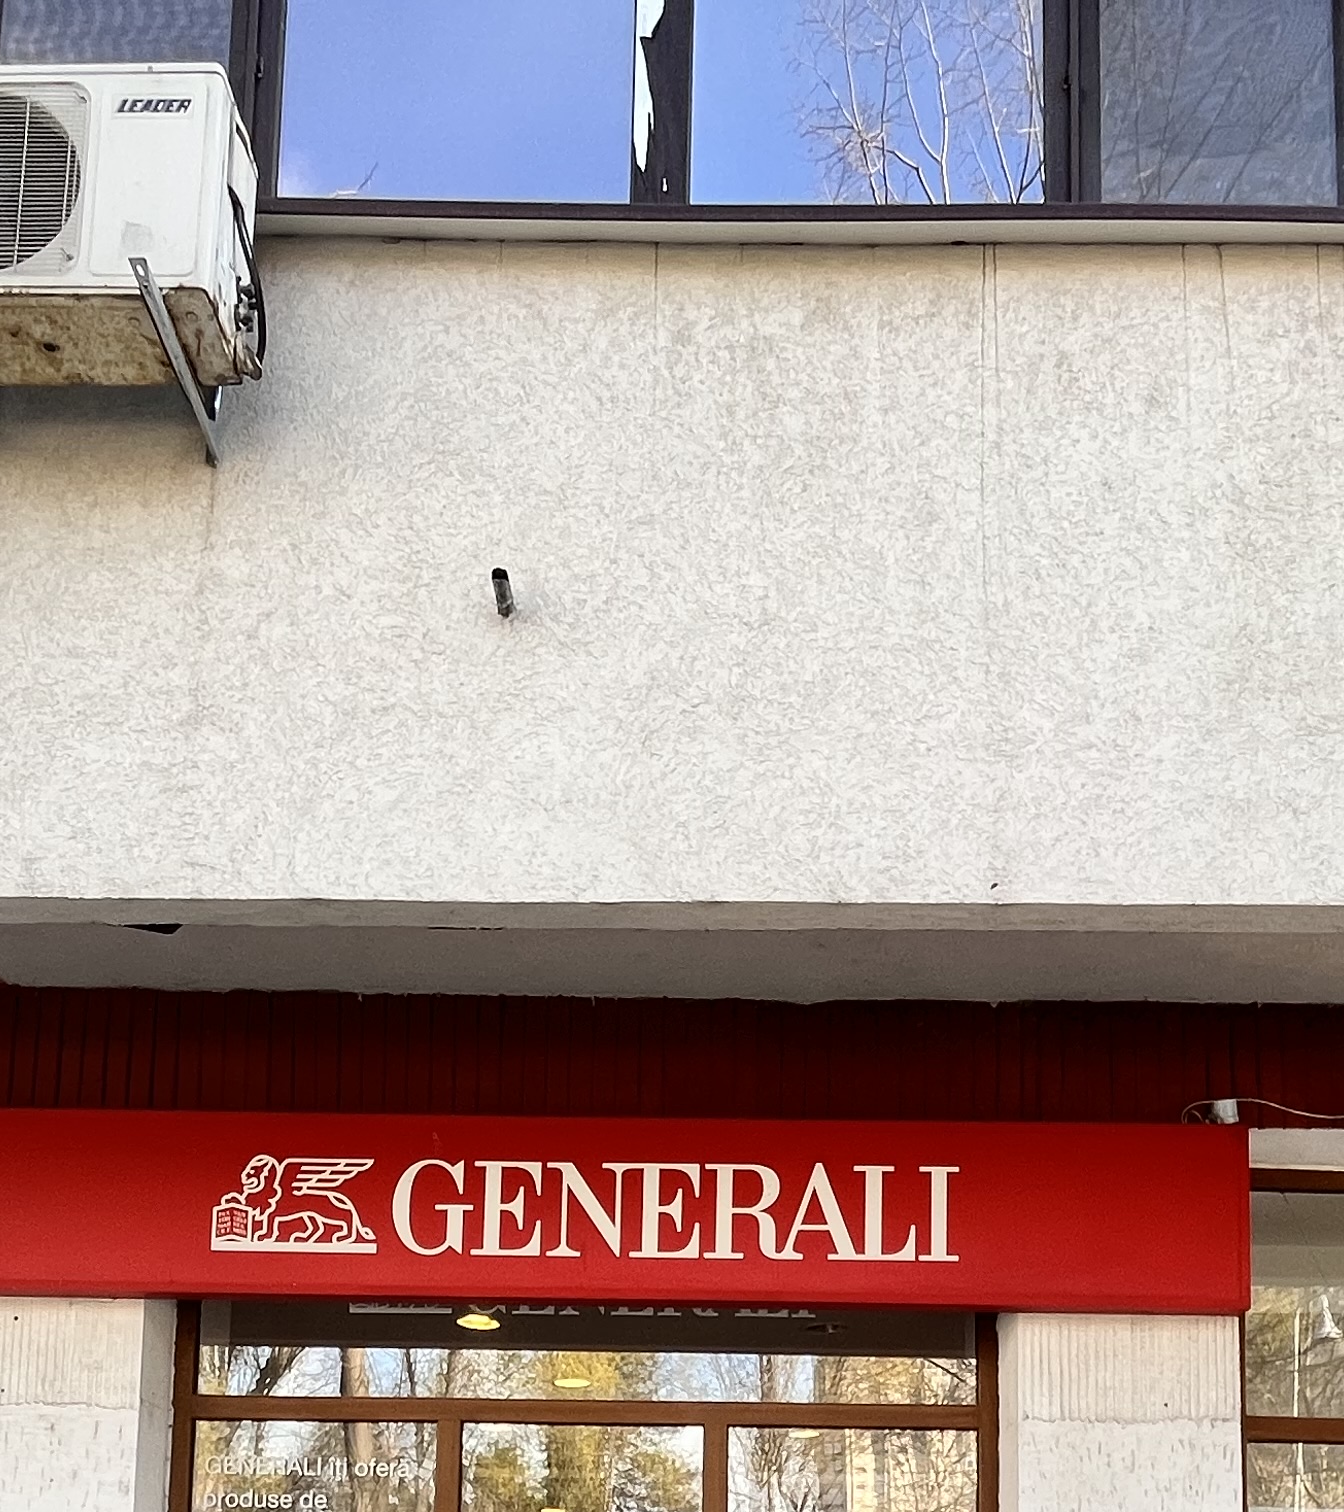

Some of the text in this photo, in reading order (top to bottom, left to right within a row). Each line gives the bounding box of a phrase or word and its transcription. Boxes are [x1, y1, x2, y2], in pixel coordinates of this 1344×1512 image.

[117, 98, 192, 114] LEADER
[390, 1158, 960, 1263] GENERALI
[203, 1491, 327, 1512] produse de
